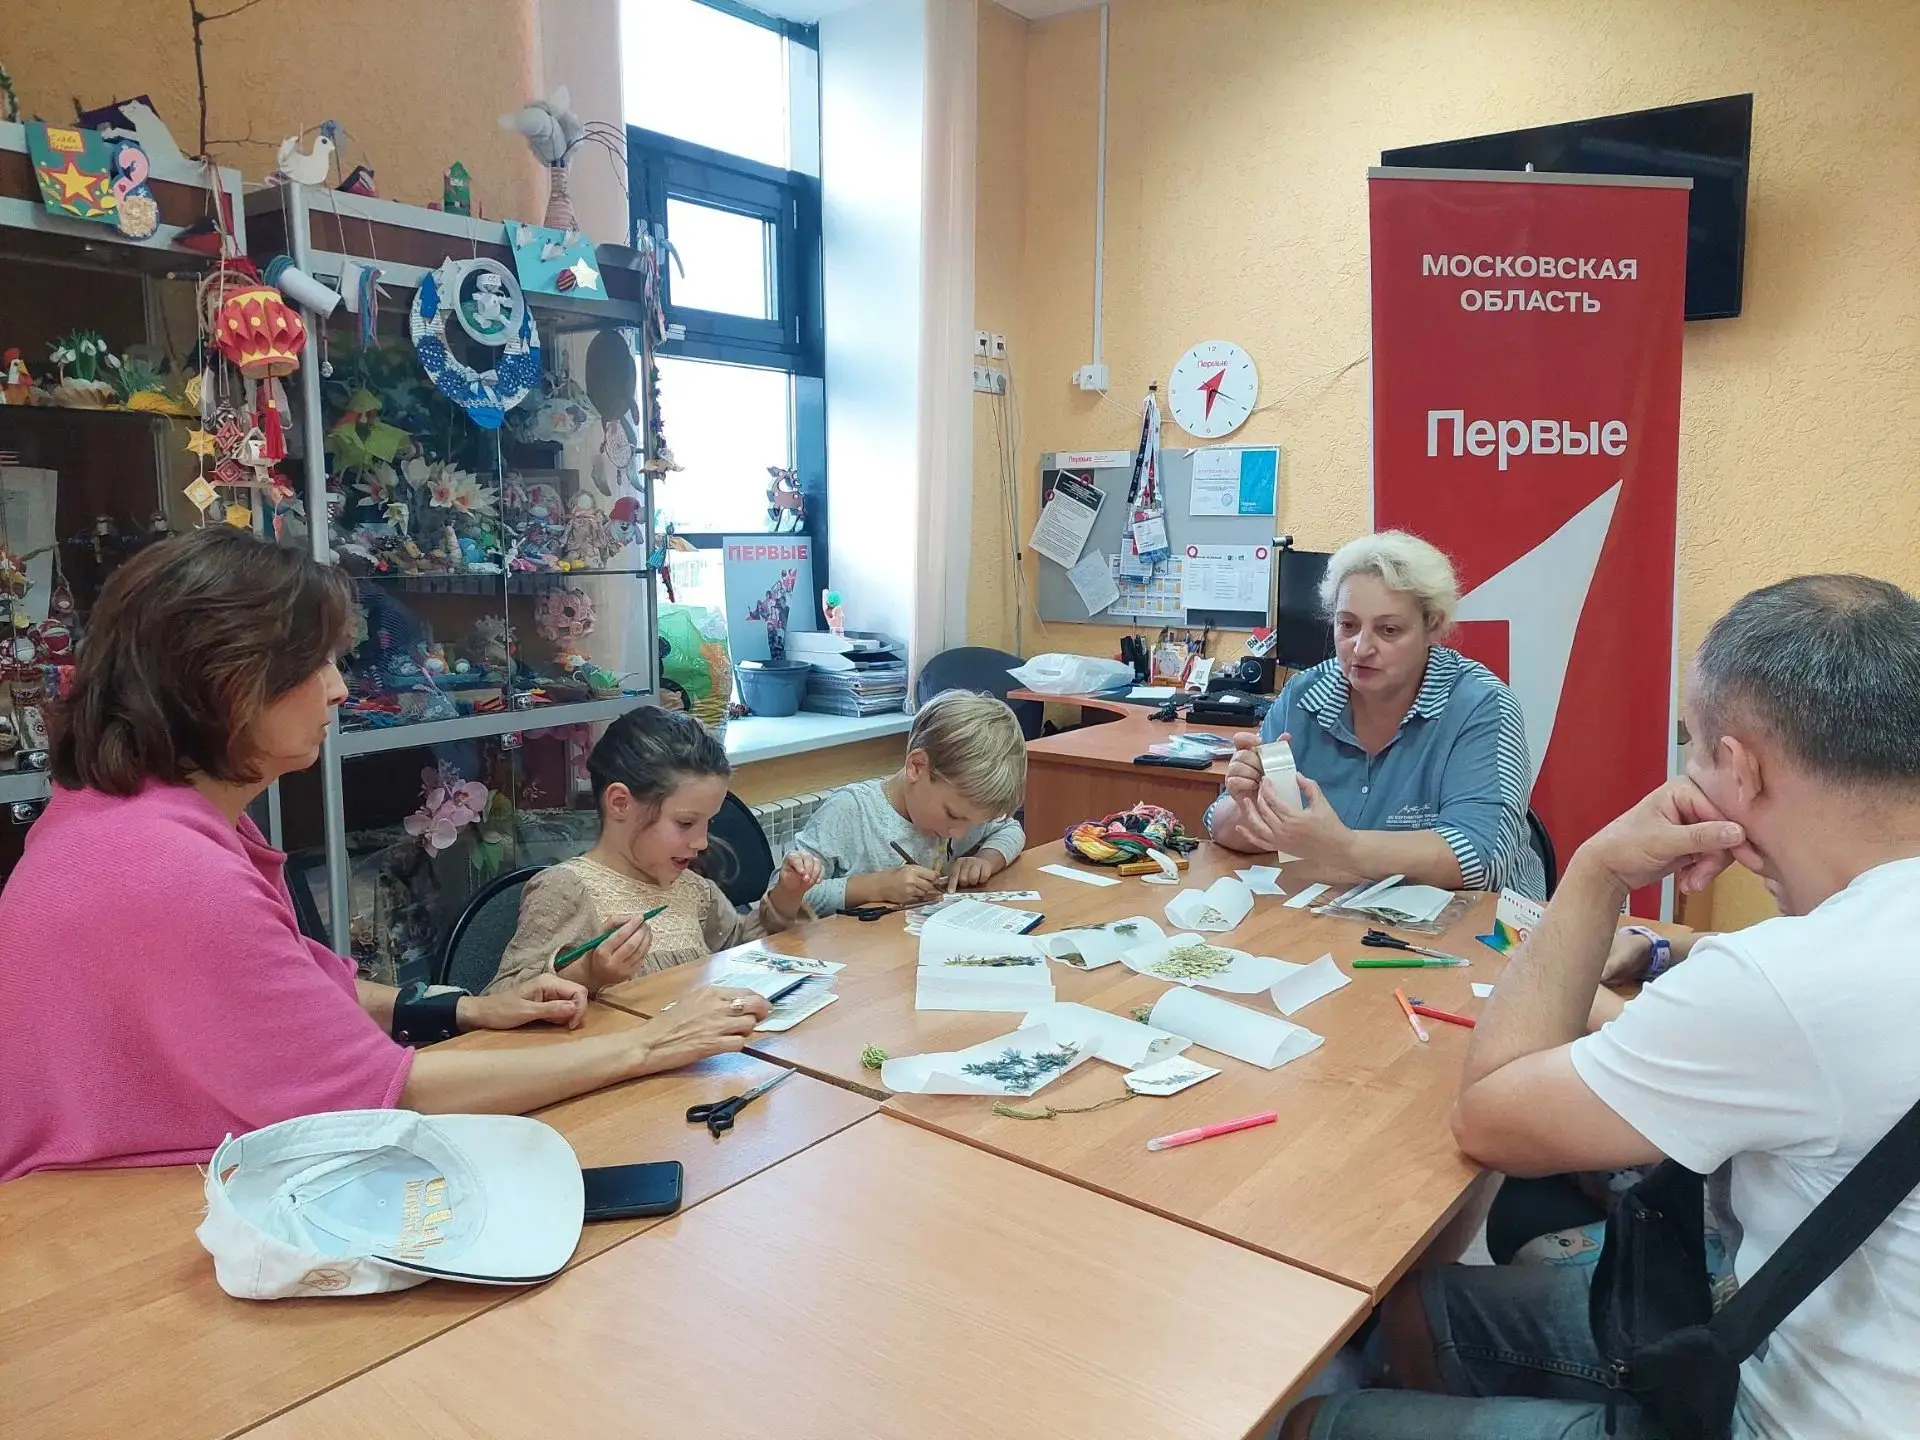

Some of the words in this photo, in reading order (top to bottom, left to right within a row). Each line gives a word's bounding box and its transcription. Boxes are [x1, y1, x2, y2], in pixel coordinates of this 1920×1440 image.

[1421, 254, 1638, 280] МОСКОВСКАЯ
[1459, 289, 1601, 314] ОБЛАСТЬ
[1426, 409, 1629, 472] Первые
[728, 544, 808, 561] ПЕРВЫЕ
